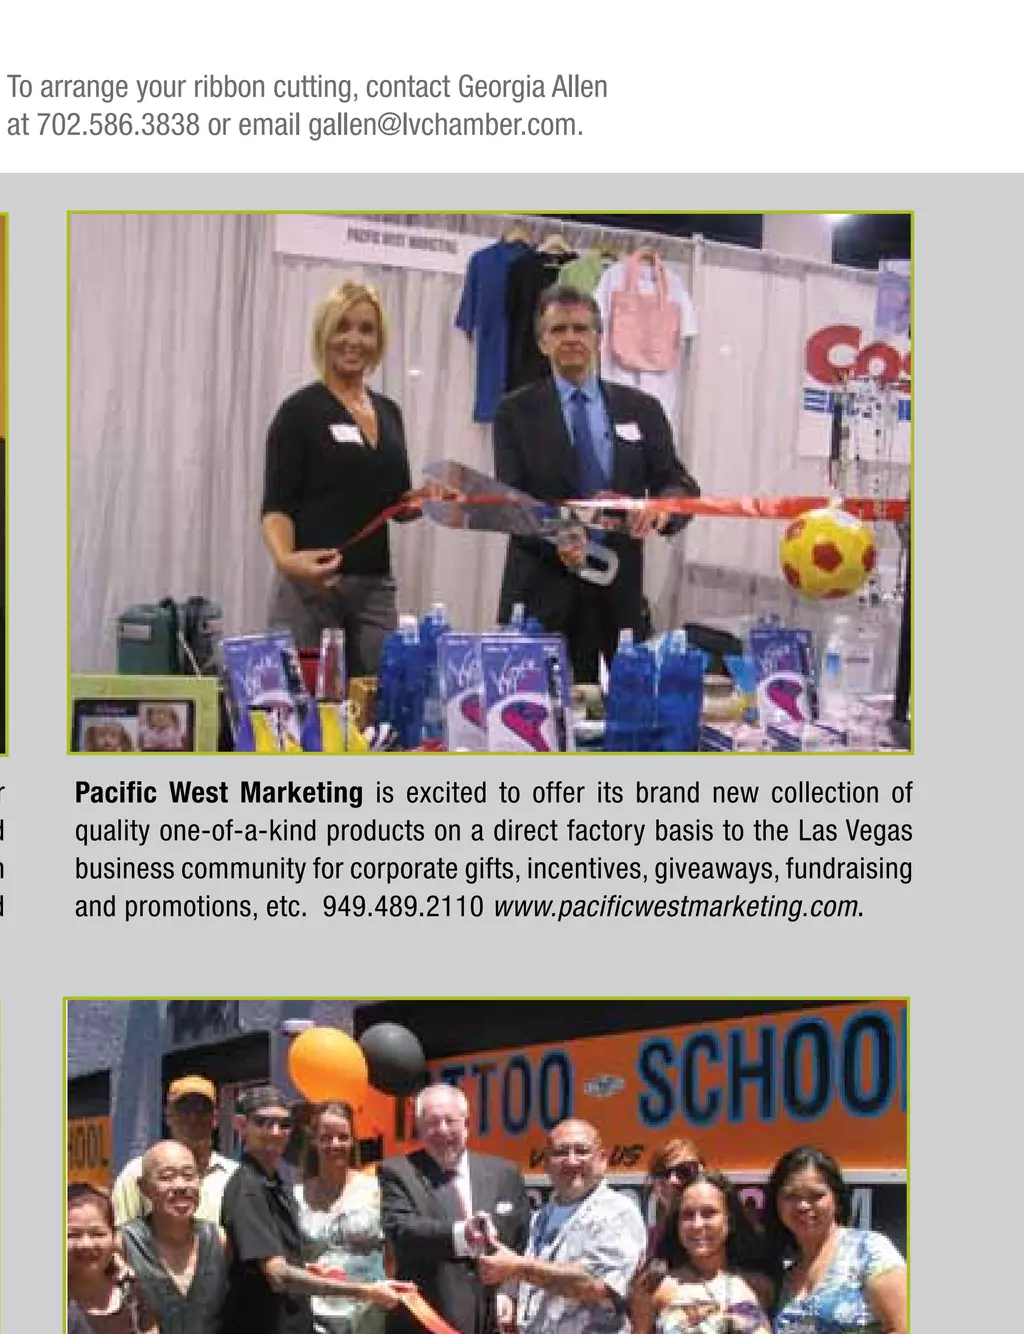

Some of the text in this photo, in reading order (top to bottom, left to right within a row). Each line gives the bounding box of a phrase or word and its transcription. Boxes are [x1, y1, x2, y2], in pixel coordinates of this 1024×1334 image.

[7, 74, 607, 103] To arrange your ribbon cutting, contact Georgia Allen
[8, 112, 582, 141] at 702.586.3838 or email gallen@lvchamber.com.
[76, 781, 913, 808] Pacific West Marketing is excited to offer its brand new collection of
[76, 895, 862, 922] and promotions, etc. 949.489.2110 www.pacificwestmarketing.com.
[638, 1008, 907, 1129] SCHOO
